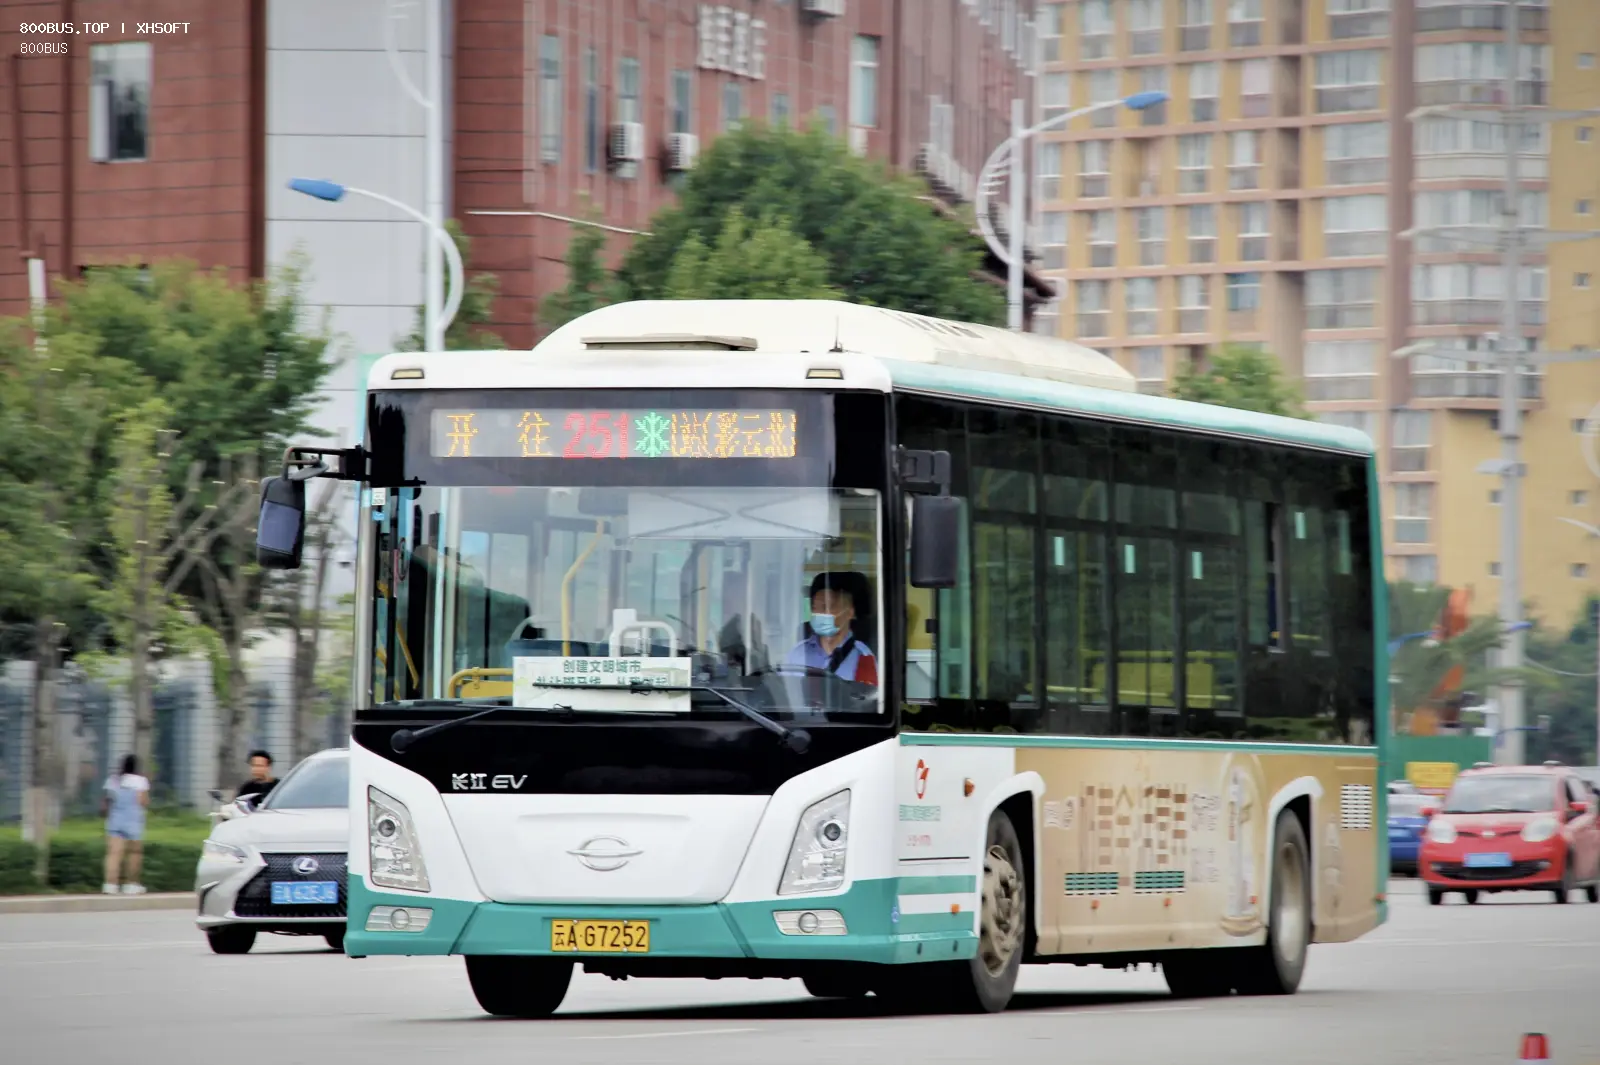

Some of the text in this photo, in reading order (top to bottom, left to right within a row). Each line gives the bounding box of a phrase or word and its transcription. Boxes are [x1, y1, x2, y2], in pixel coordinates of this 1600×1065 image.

[561, 411, 630, 458] 251
[563, 660, 641, 673] 创建文明城市
[452, 773, 528, 790] 长江 EV
